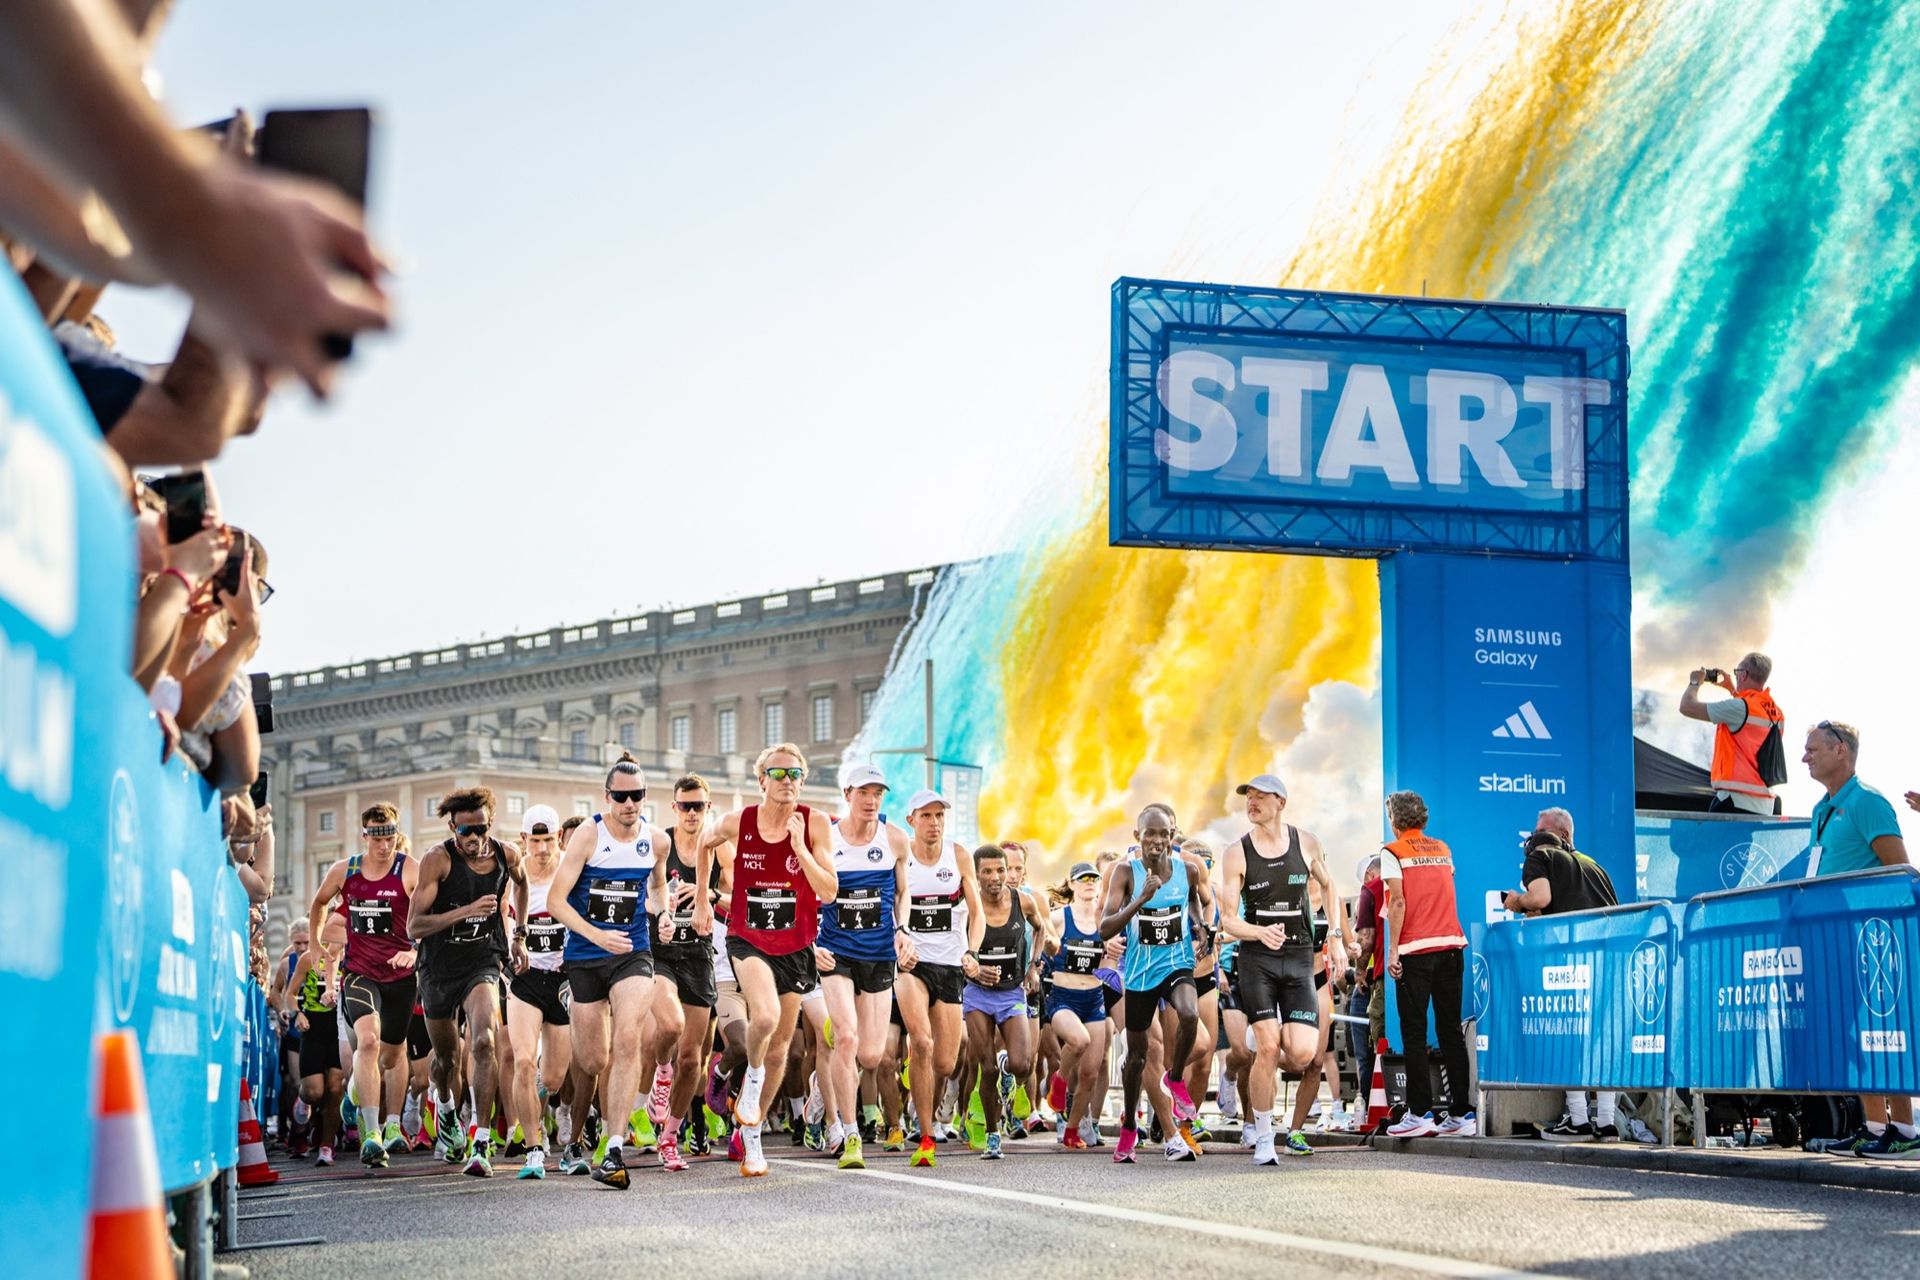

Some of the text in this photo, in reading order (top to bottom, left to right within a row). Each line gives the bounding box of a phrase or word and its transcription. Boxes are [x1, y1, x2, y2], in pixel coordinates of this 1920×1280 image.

[1154, 349, 1611, 490] START
[1475, 627, 1562, 647] SAMSUNG
[1475, 648, 1538, 671] Galaxy
[1479, 772, 1566, 795] stadium
[602, 895, 624, 903] DANIEL
[607, 904, 616, 917] 6
[761, 902, 781, 910] DAVID
[366, 917, 375, 929] 8
[767, 911, 775, 924] 2
[855, 911, 862, 922] 4
[925, 916, 933, 927] 3
[472, 924, 480, 937] 7
[680, 928, 687, 940] 5
[1155, 927, 1168, 940] 50
[540, 936, 550, 947] 10
[1076, 956, 1091, 968] 109
[1718, 982, 1804, 1007] STOCKHOLM
[1521, 994, 1591, 1013] STOCKHOLM
